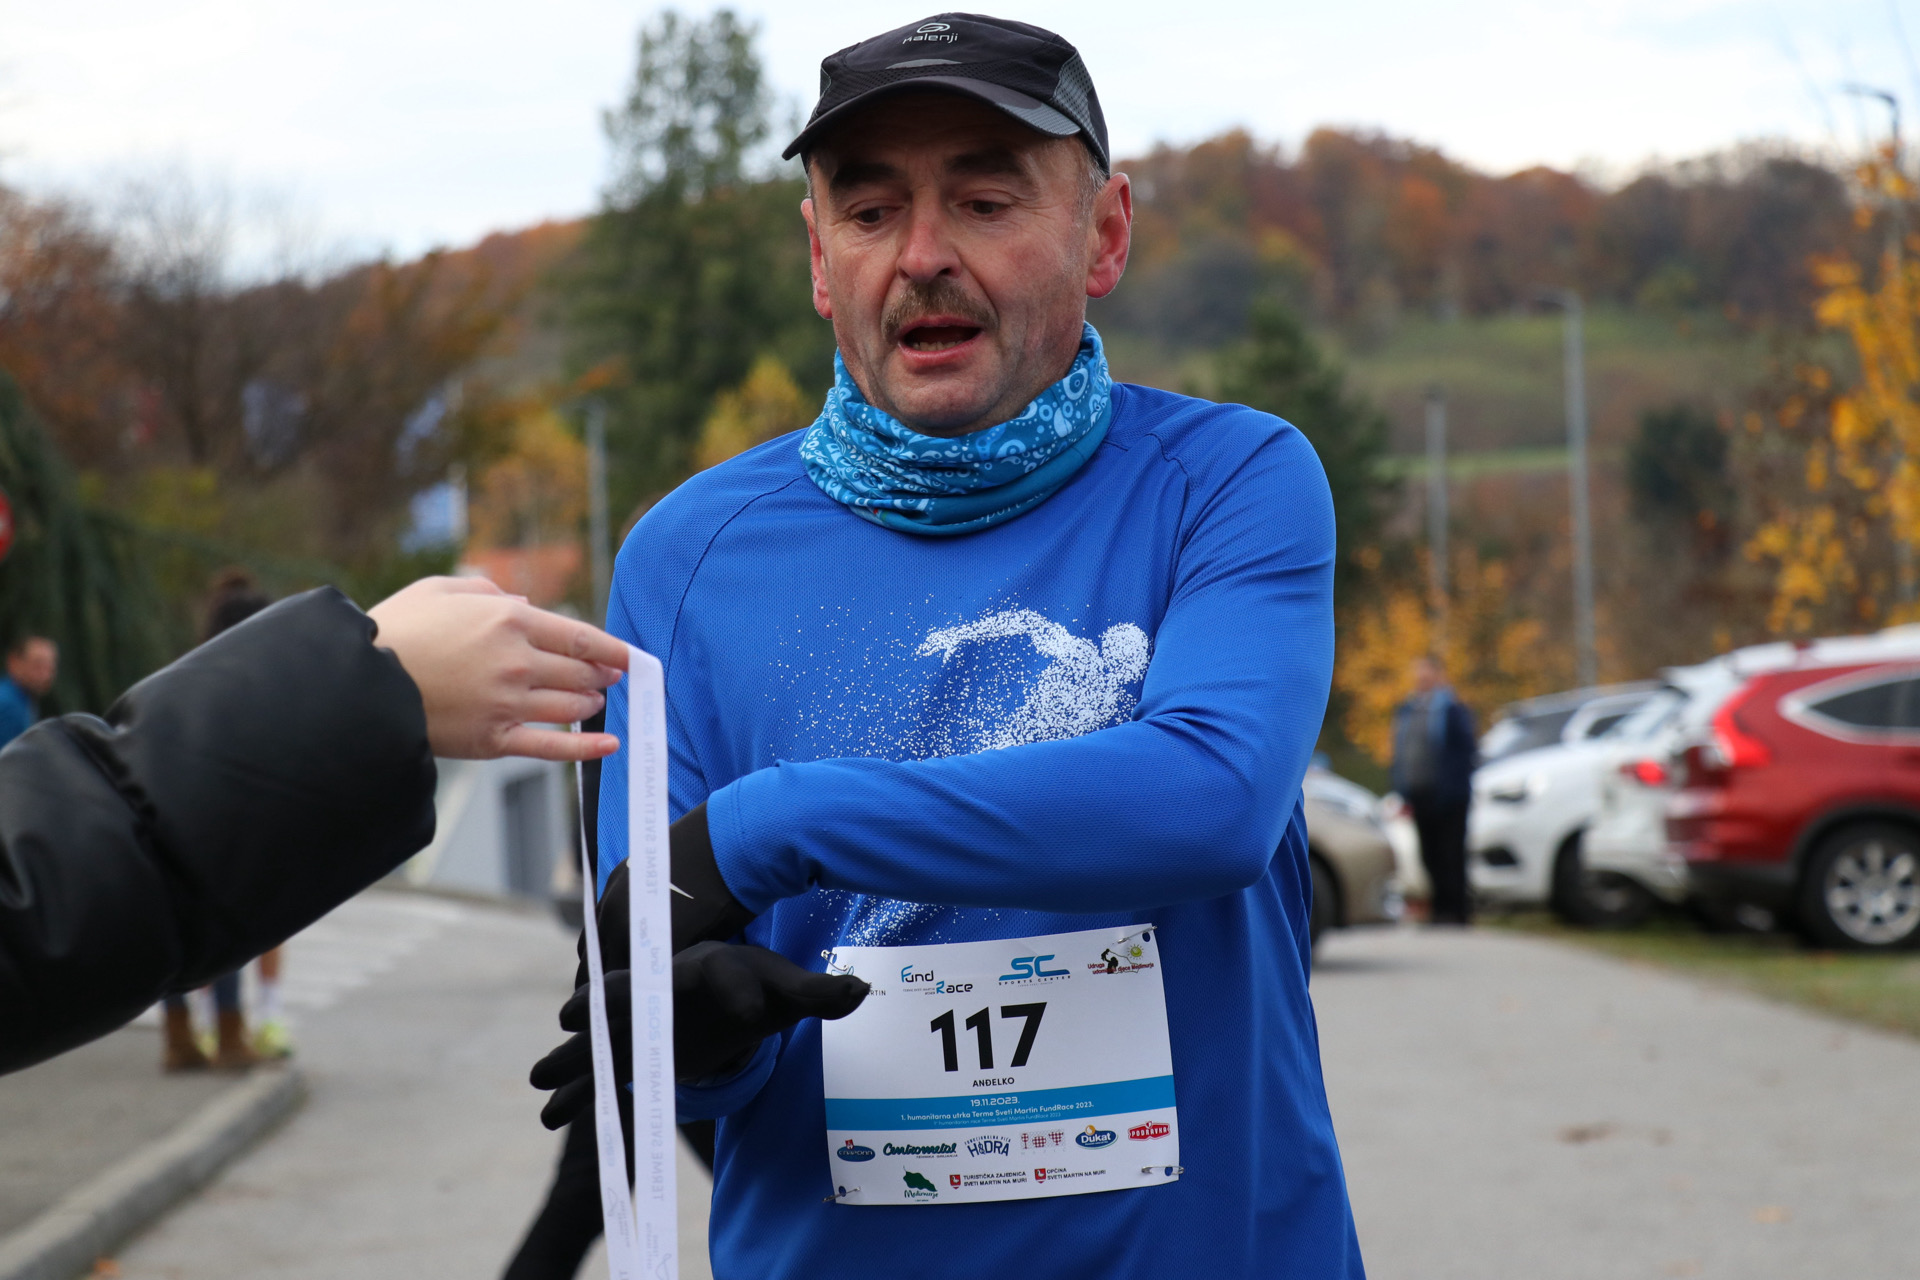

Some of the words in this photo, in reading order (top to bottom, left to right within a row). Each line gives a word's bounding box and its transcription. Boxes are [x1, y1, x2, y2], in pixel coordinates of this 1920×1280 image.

[901, 965, 934, 983] Fund
[998, 954, 1071, 981] SC
[936, 980, 973, 994] Race
[930, 1002, 1048, 1072] 117
[972, 1077, 1015, 1088] ANĐELKO
[971, 1096, 1021, 1107] 19.11.2023.
[972, 1110, 994, 1118] Terme
[995, 1107, 1013, 1116] Sveti
[1014, 1106, 1038, 1115] Martin
[1039, 1104, 1074, 1112] FundRace
[1075, 1101, 1094, 1109] 2023.
[1081, 1132, 1112, 1144] Dukat
[1131, 1126, 1168, 1138] PODRAVKA
[883, 1142, 957, 1156] Centrometal
[979, 1179, 1002, 1187] MARTIN
